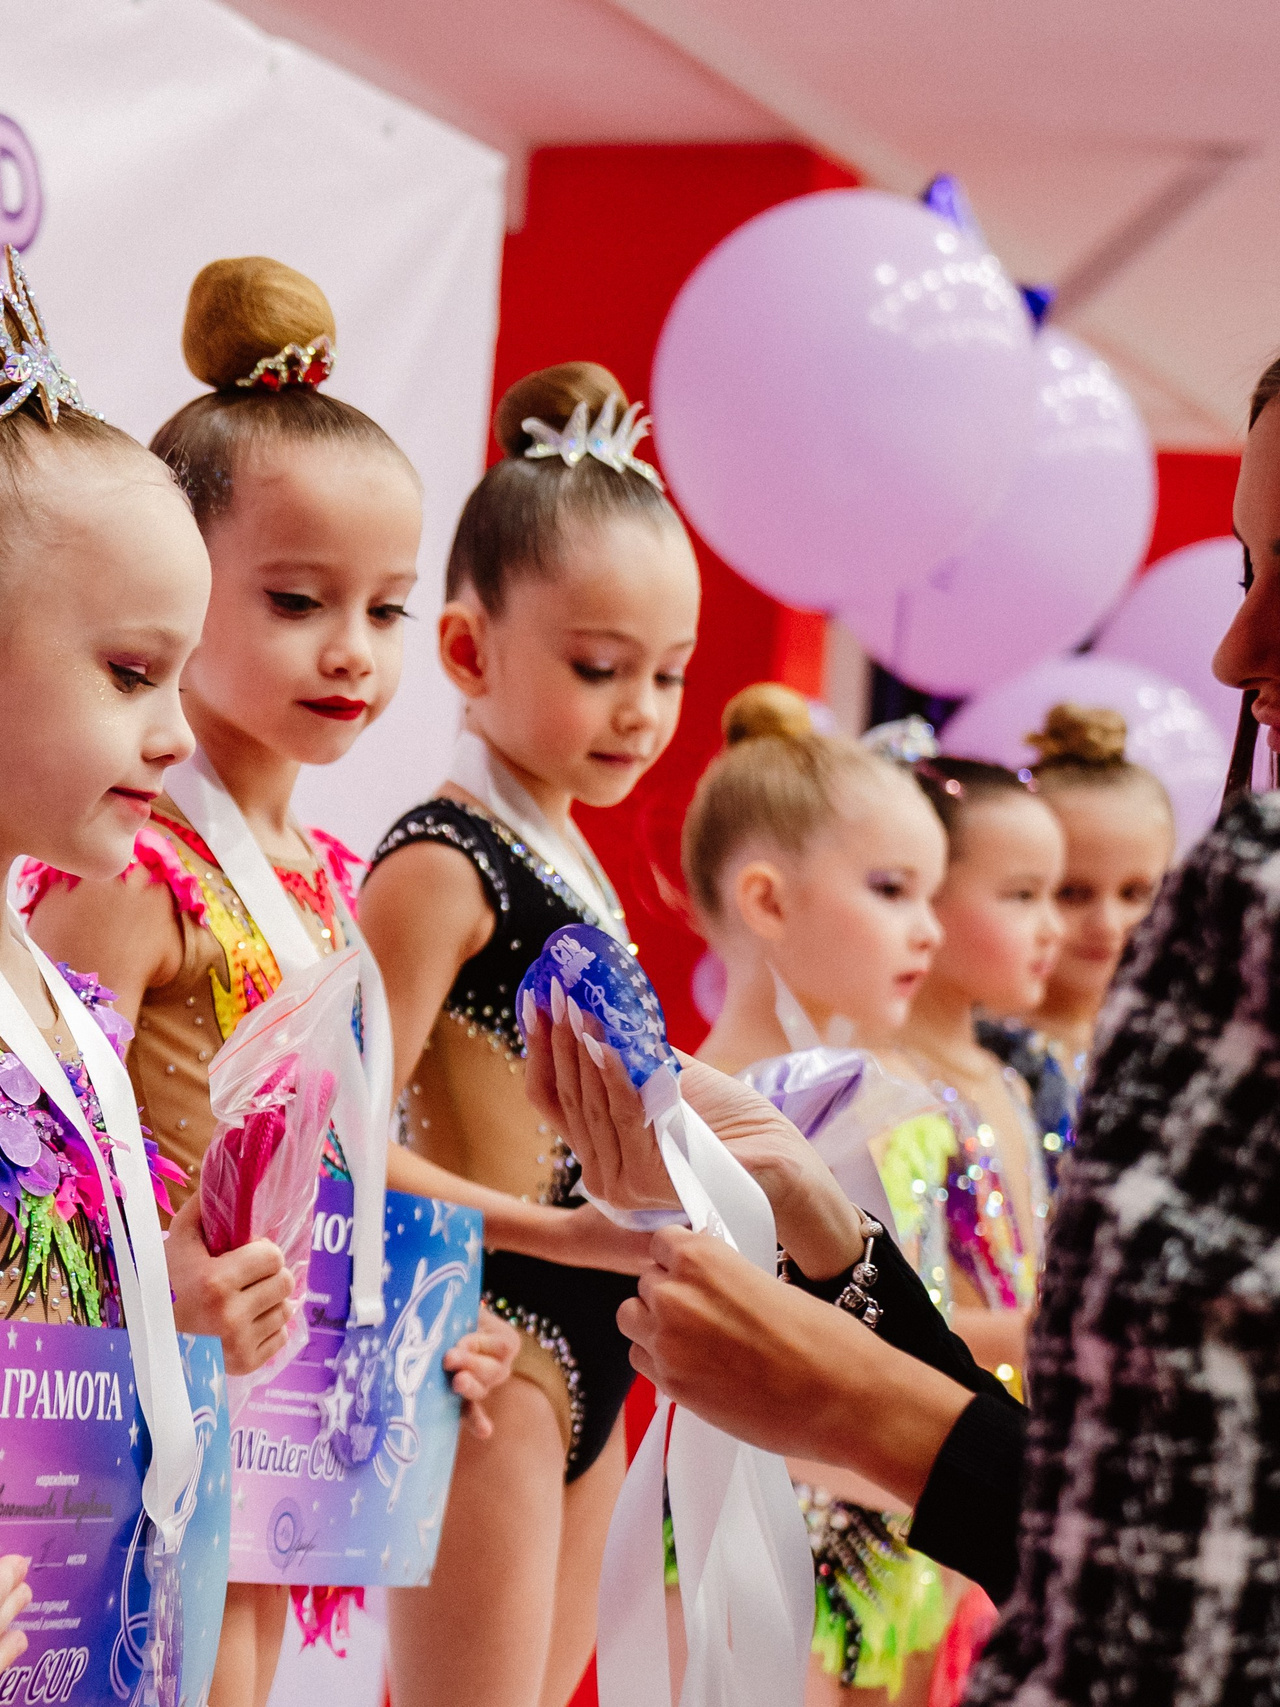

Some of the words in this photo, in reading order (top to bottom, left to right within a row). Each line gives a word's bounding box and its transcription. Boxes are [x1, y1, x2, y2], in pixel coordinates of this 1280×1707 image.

[0, 1367, 123, 1421] ГРАМОТА
[229, 1426, 310, 1478] Winter
[24, 1646, 90, 1705] CUP
